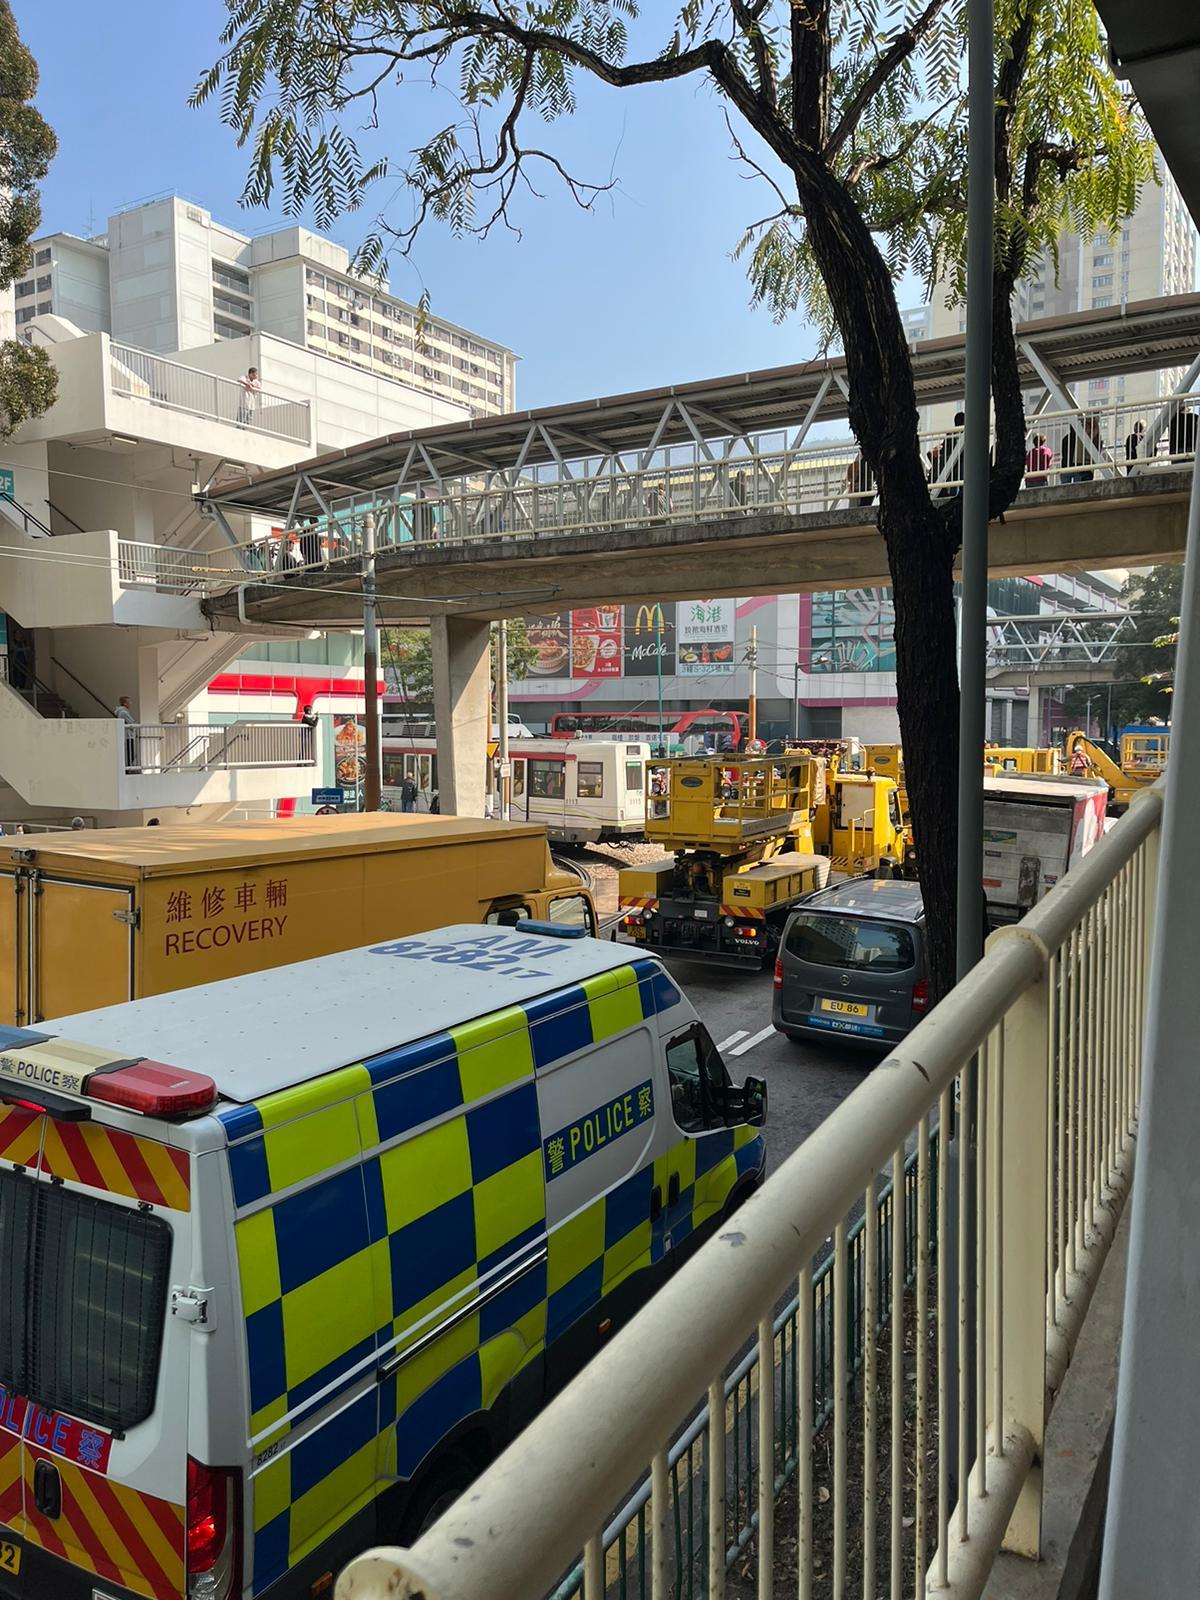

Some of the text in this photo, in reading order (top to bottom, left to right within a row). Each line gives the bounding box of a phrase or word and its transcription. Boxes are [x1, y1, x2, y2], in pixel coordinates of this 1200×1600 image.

[165, 878, 288, 923] 維修車輛
[165, 915, 288, 956] RECOVERY
[450, 934, 571, 959] AM
[734, 938, 760, 946] VOLVO
[367, 941, 521, 972] 8282
[830, 1001, 859, 1014] EU 86
[17, 1061, 60, 1087] POLICE
[62, 1073, 80, 1092] 察
[547, 1086, 652, 1174] 警 POLICE 察
[76, 1429, 105, 1470] 察
[257, 1441, 279, 1466] 8282
